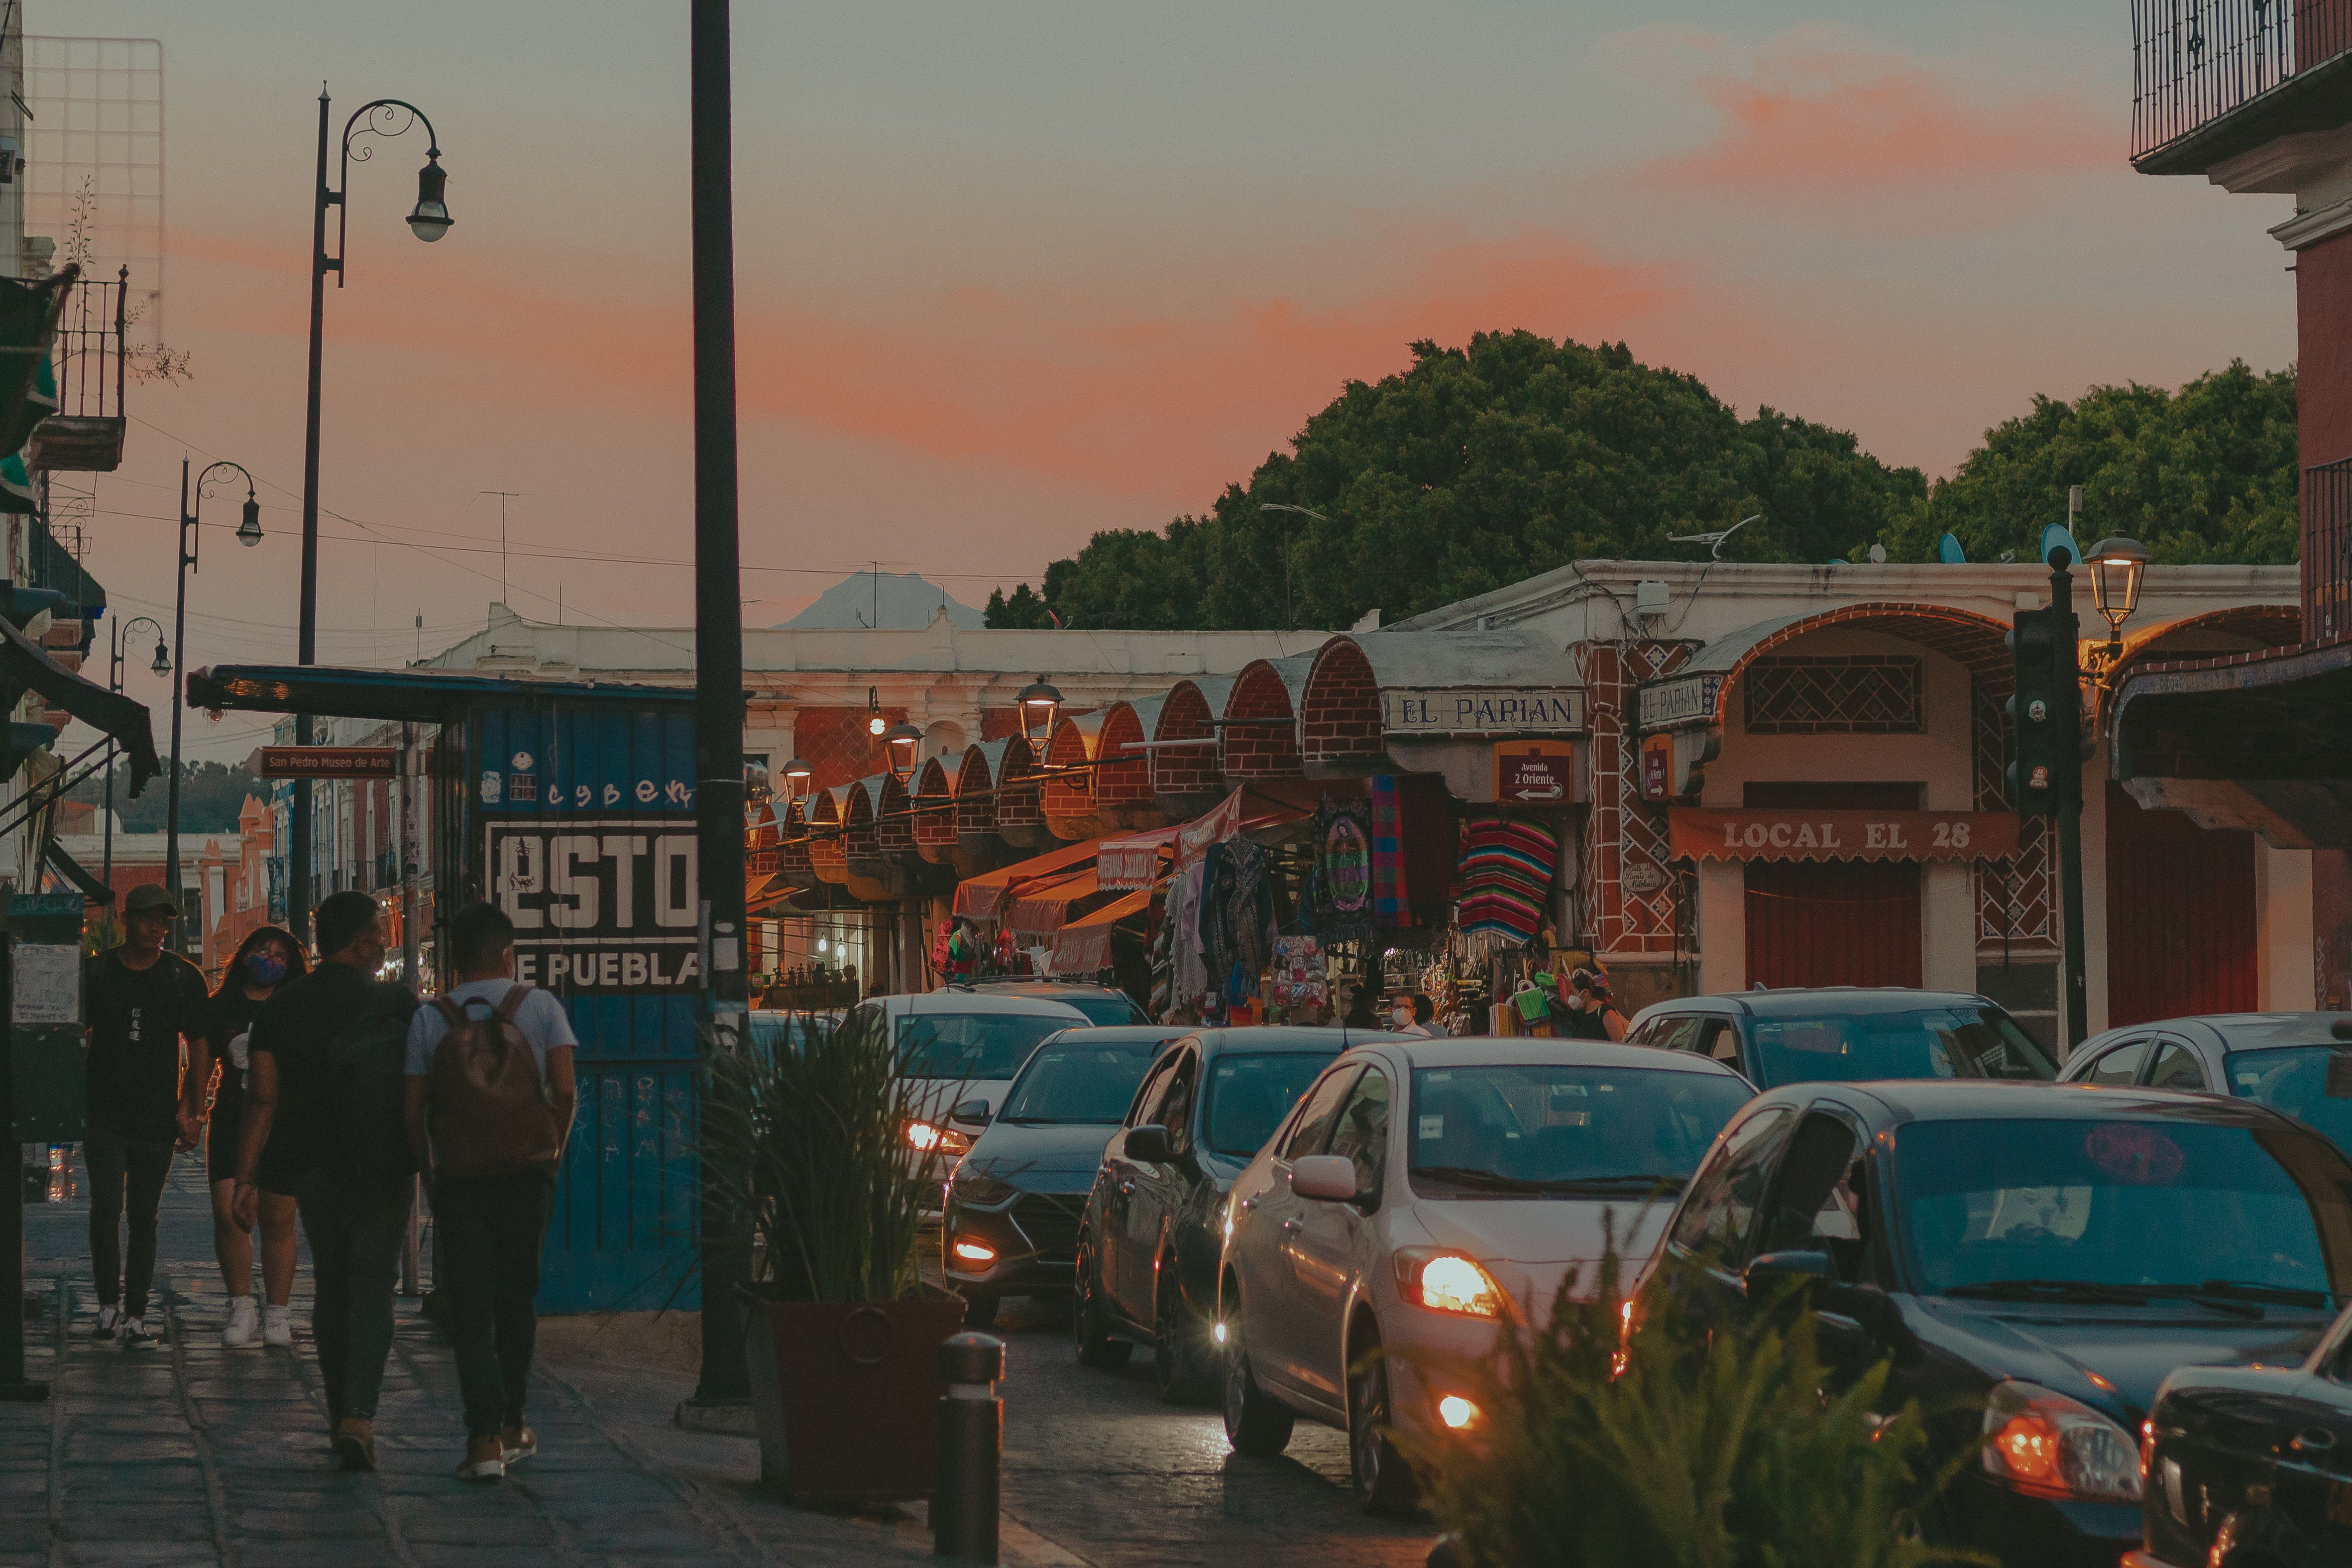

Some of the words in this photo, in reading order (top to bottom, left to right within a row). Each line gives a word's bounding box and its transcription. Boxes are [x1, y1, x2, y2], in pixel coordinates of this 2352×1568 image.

[1402, 699, 1438, 723] EL
[1455, 698, 1572, 724] PARIAN
[1643, 693, 1656, 720] EL
[1660, 684, 1699, 717] PARIAN
[269, 757, 287, 768] San
[290, 756, 318, 768] Pedro
[321, 757, 352, 768] Museo
[355, 757, 367, 768] de
[370, 758, 390, 768] Arte
[1521, 763, 1548, 772] Avenida
[1514, 773, 1520, 784] 2
[1523, 773, 1555, 784] Oriente
[1723, 822, 1841, 848] LOCAL
[1864, 823, 1907, 848] EL
[1932, 821, 1971, 848] 28
[513, 954, 537, 987] E
